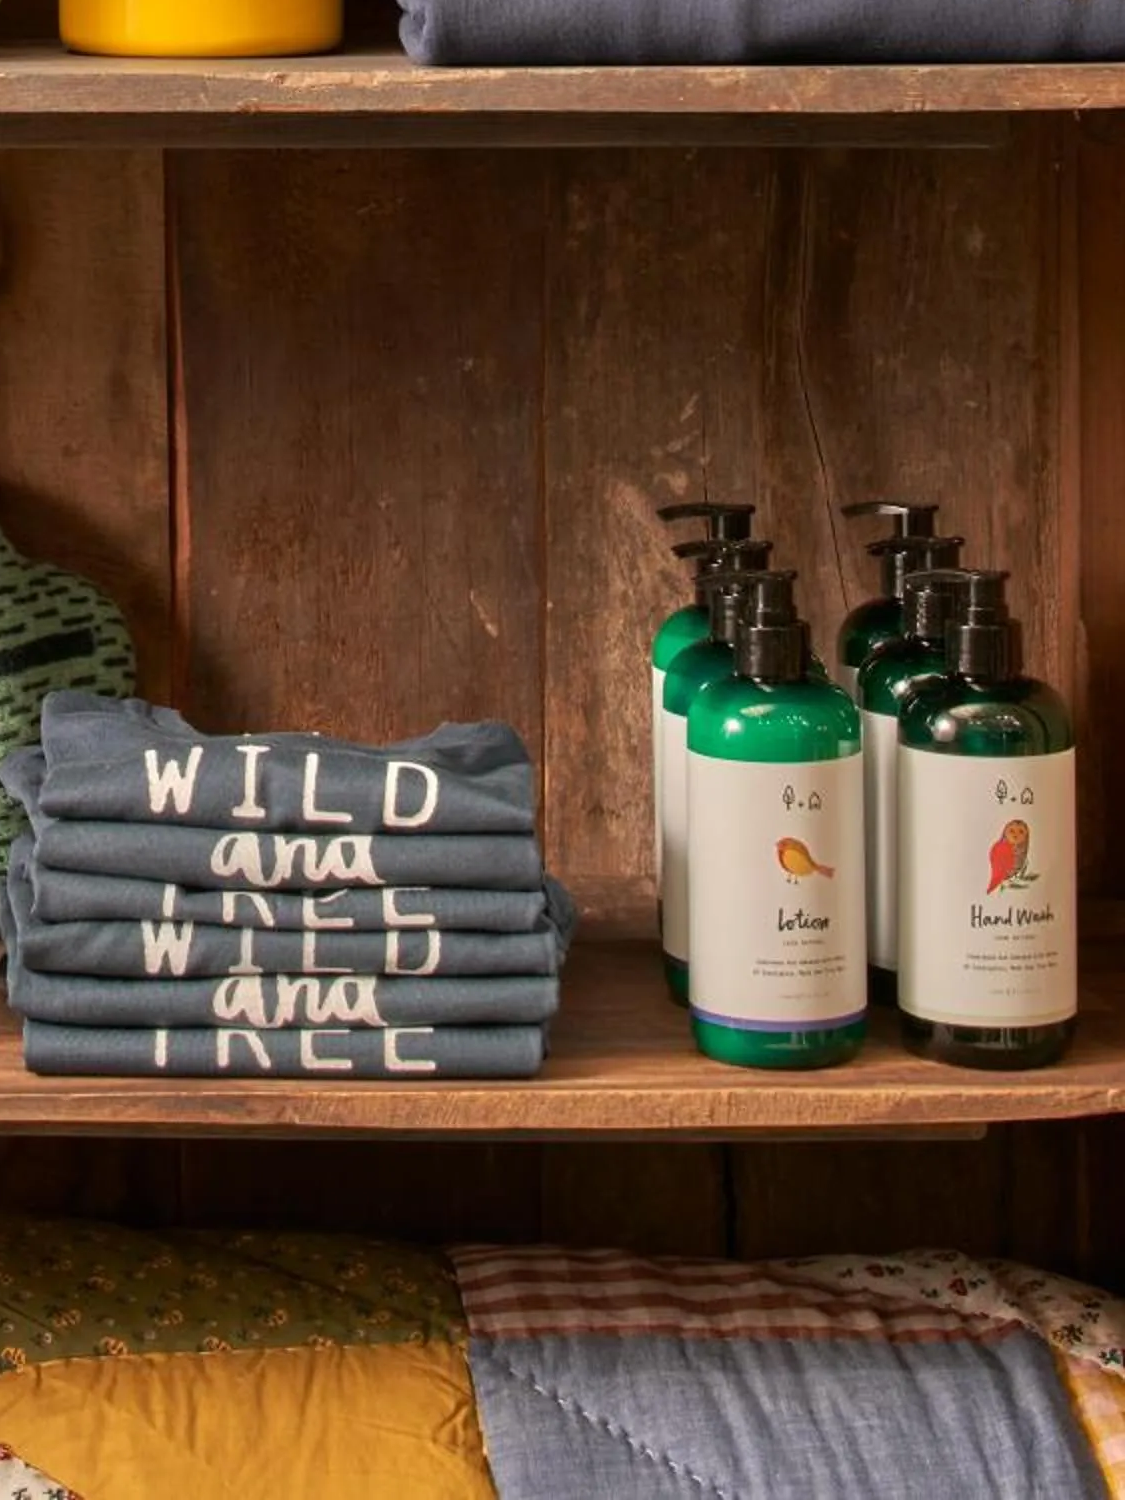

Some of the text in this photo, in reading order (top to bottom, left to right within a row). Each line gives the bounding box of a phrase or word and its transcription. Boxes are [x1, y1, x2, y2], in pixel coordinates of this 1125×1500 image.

[144, 744, 440, 828] WILD
[970, 901, 1055, 929] Hand Wash
[141, 919, 442, 977] WILD
